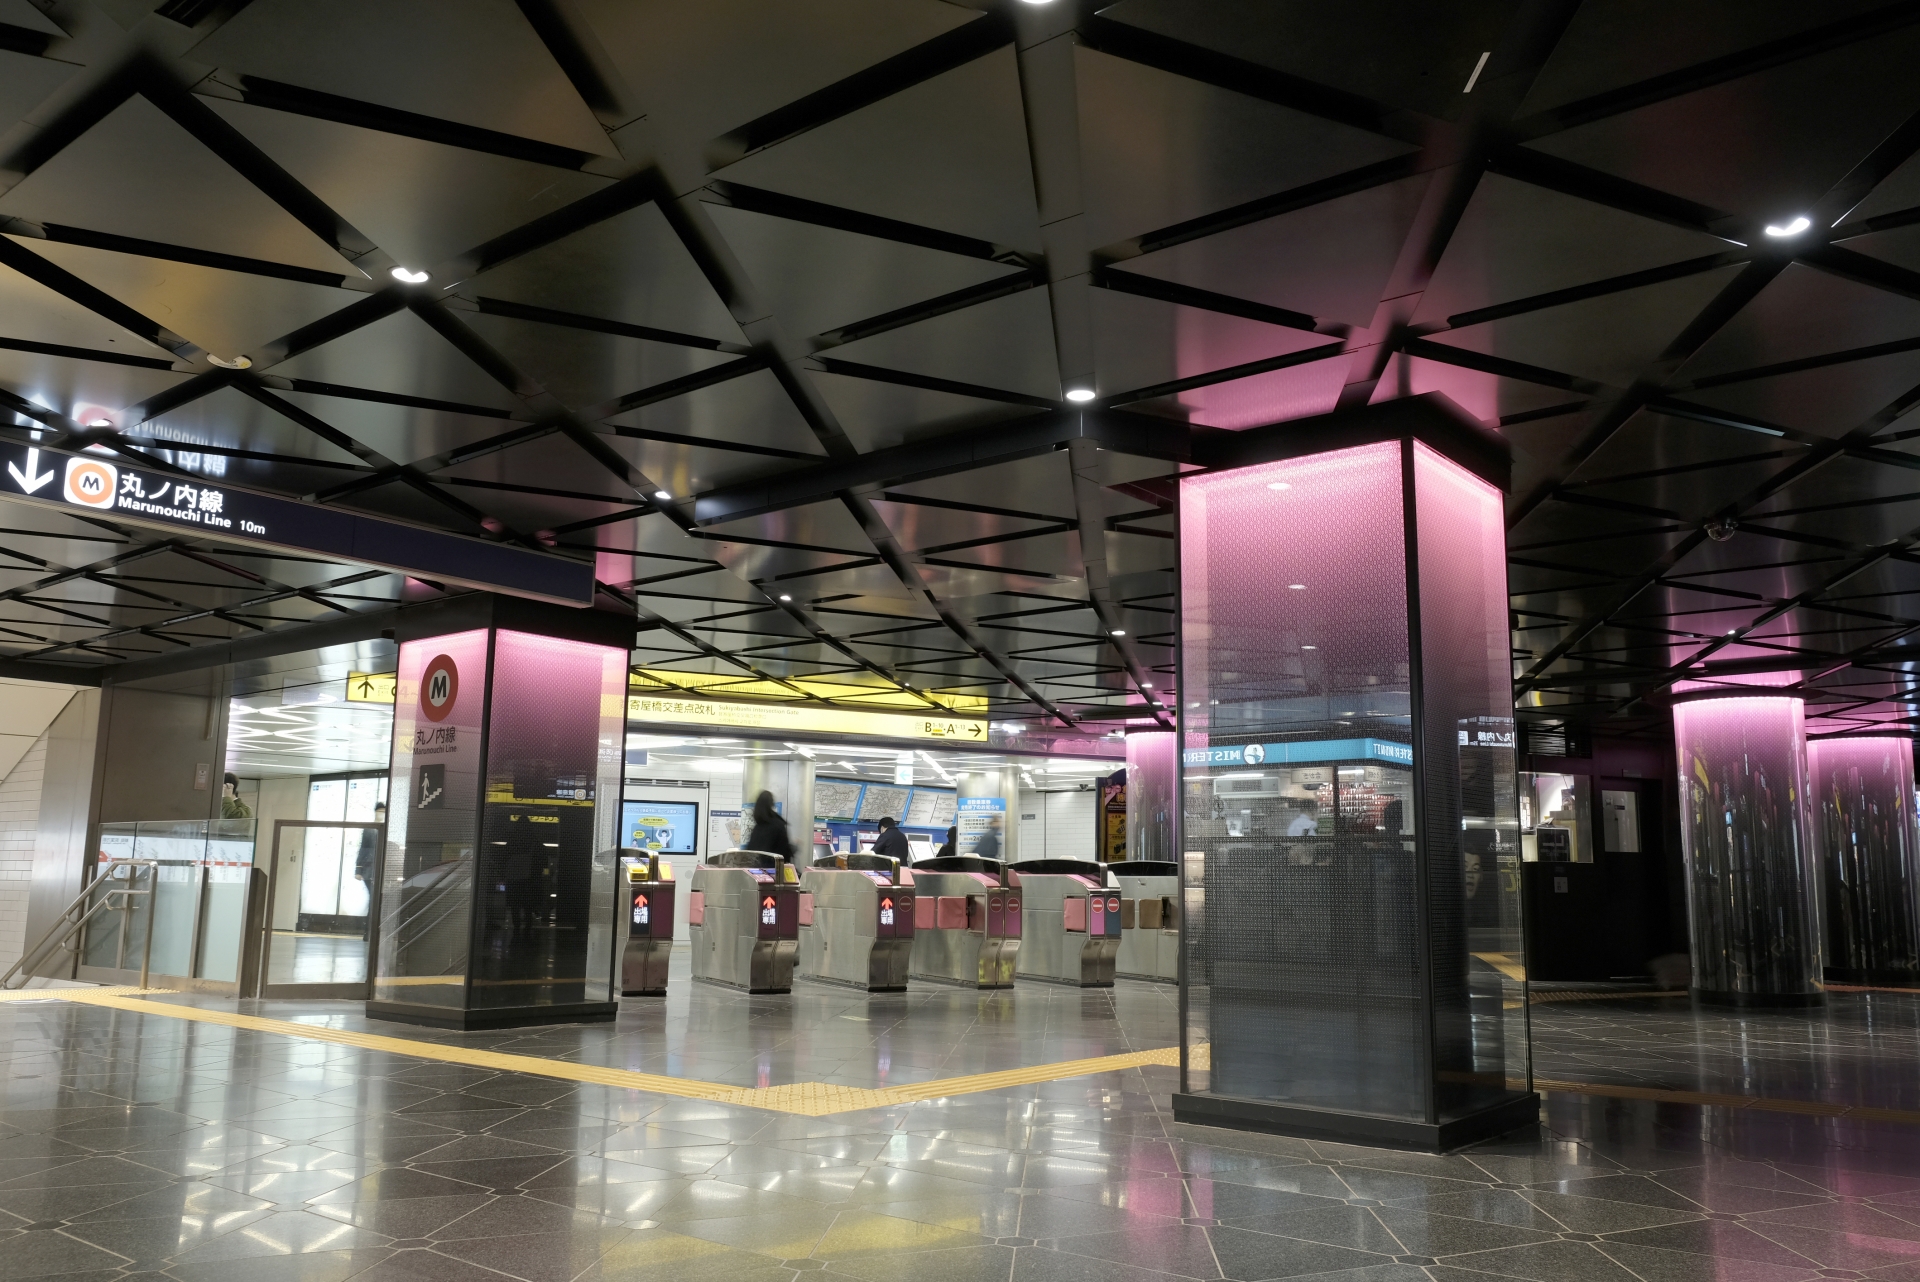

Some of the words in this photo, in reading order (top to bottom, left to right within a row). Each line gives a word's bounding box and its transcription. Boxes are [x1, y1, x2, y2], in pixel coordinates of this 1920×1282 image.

[120, 472, 223, 513] 丸ノ内線
[118, 495, 201, 522] Marunouchi
[204, 512, 232, 528] Line
[240, 520, 266, 535] 10m
[628, 699, 716, 716] 寄屋橋交差点改札
[718, 704, 752, 713] Sukiyabashi
[752, 707, 785, 715] Intersection
[415, 726, 456, 745] 丸ノ内線
[413, 746, 444, 756] Marunouchi
[445, 745, 457, 753] Line
